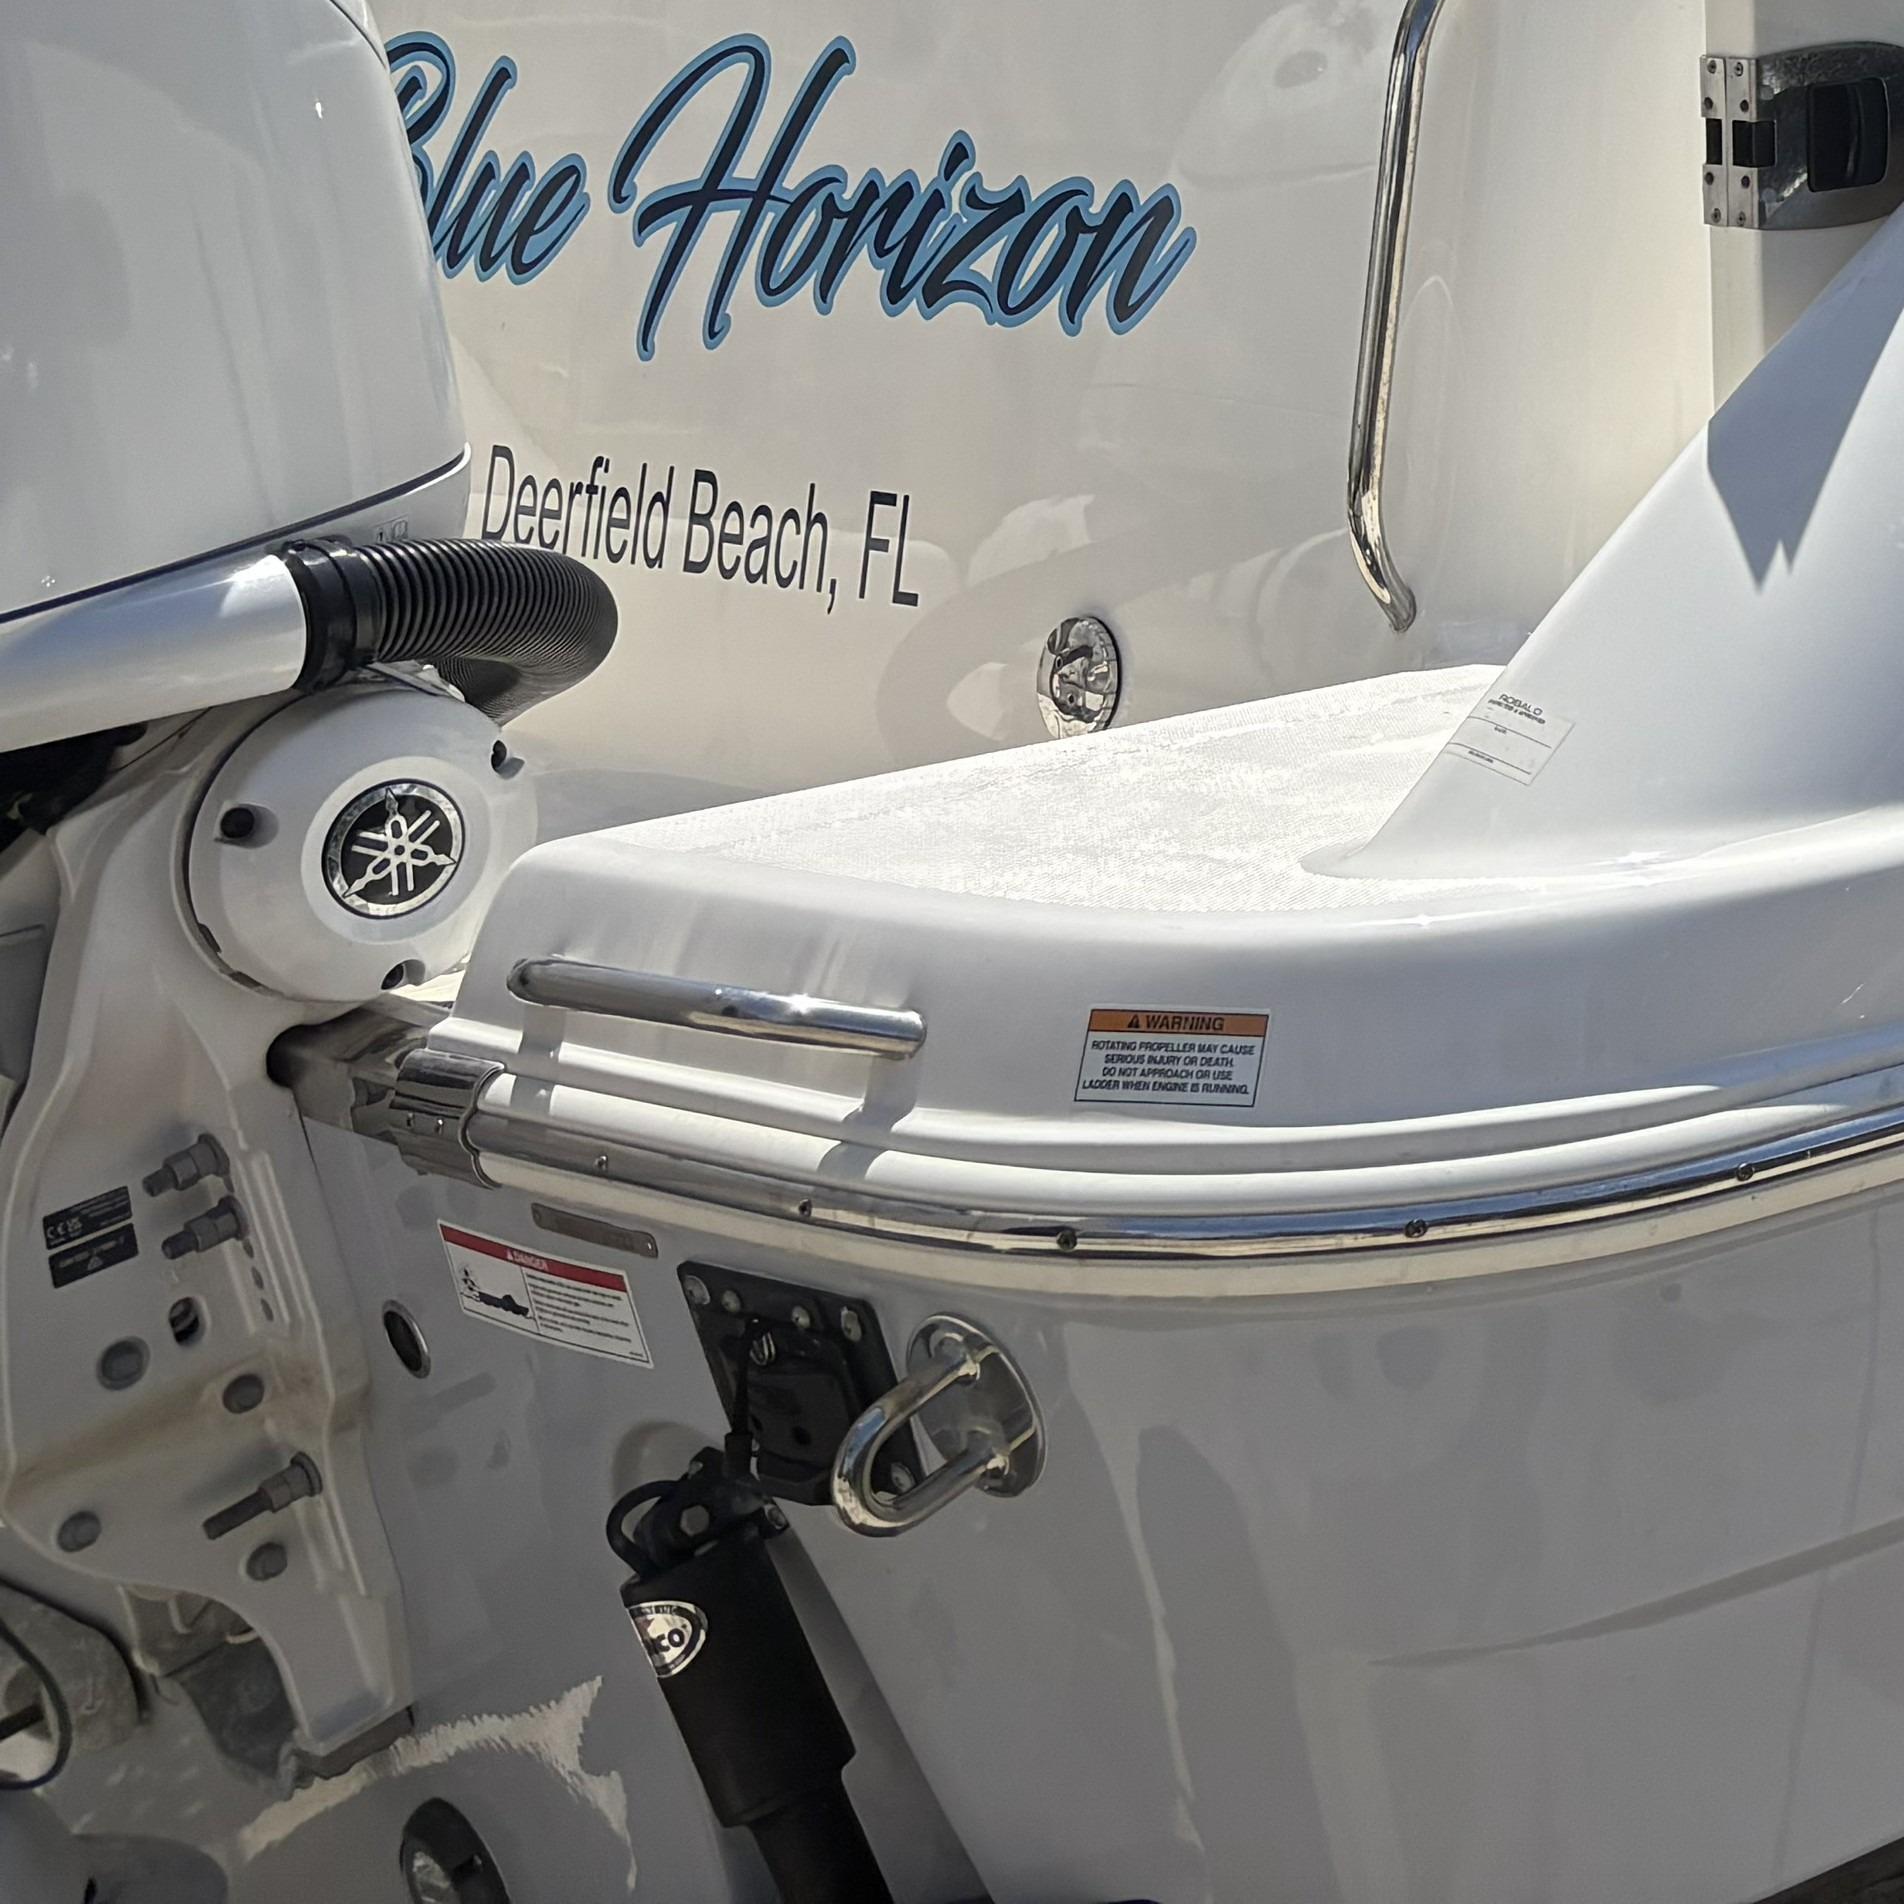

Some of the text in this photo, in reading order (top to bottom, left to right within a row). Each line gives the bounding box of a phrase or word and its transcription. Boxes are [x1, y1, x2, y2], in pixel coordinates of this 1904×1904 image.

[384, 31, 1198, 362] Blue Horizon
[481, 444, 919, 615] Deerfield Beach, FL
[1146, 1014, 1224, 1032] WARNING
[1091, 1040, 1255, 1055] ROTATING PROPELLER MAY CAUSE
[1104, 1053, 1145, 1064] SERIOUS
[1147, 1054, 1181, 1066] INJURY
[1183, 1056, 1198, 1066] OR
[1102, 1067, 1233, 1080] DO NOT APPROACH OR USE
[1082, 1080, 1120, 1090] LADDER
[1122, 1081, 1150, 1091] WHEN
[1152, 1081, 1188, 1092] ENGINE
[1190, 1083, 1200, 1093] IS
[513, 1249, 550, 1271] DANGER
